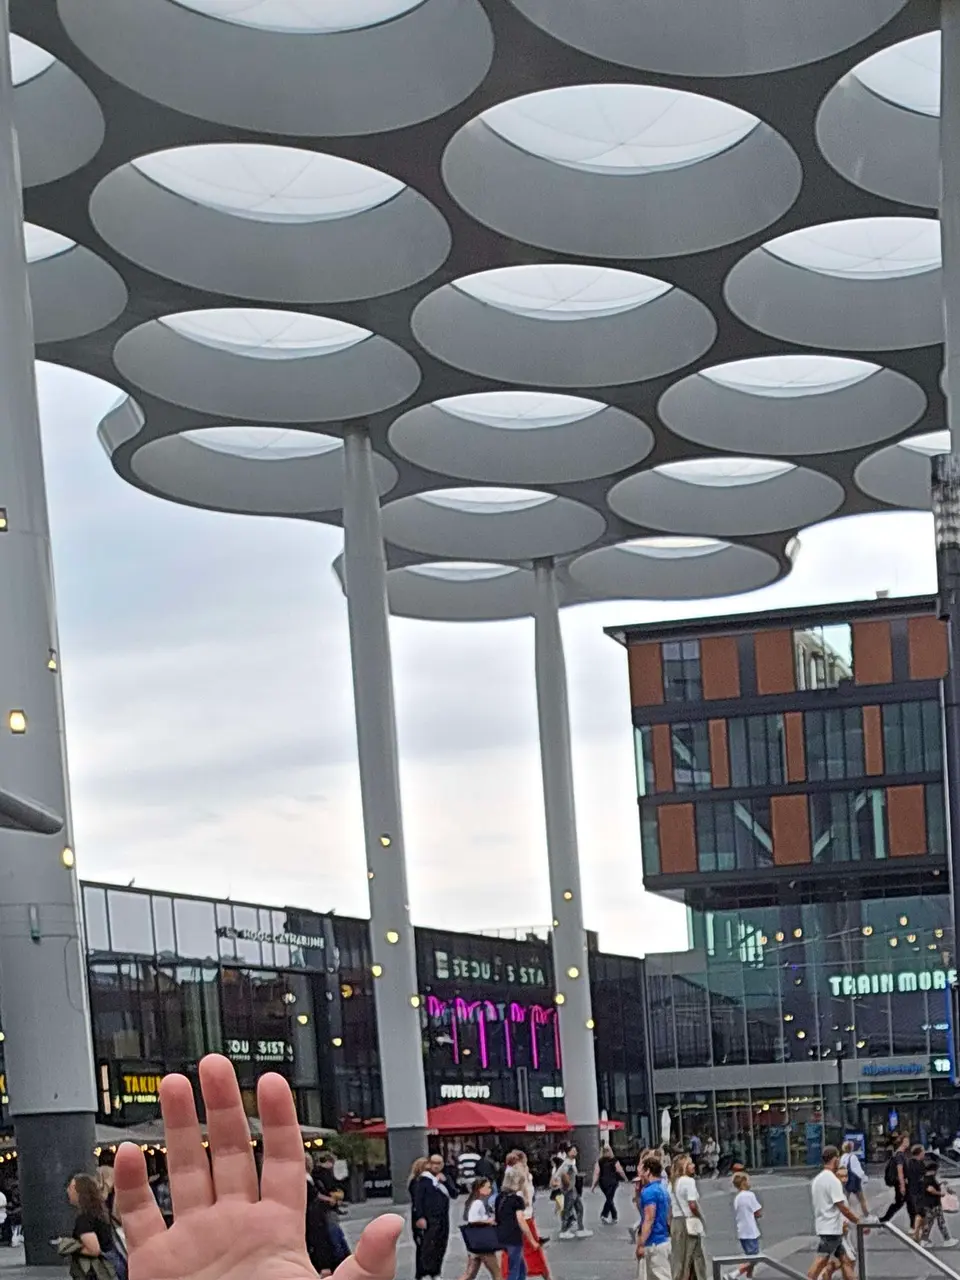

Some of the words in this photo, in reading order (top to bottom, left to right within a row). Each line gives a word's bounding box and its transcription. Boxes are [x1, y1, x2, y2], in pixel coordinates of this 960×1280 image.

[829, 973, 894, 996] TRAIN
[440, 1084, 463, 1098] FIVE
[463, 1084, 490, 1098] GUYS
